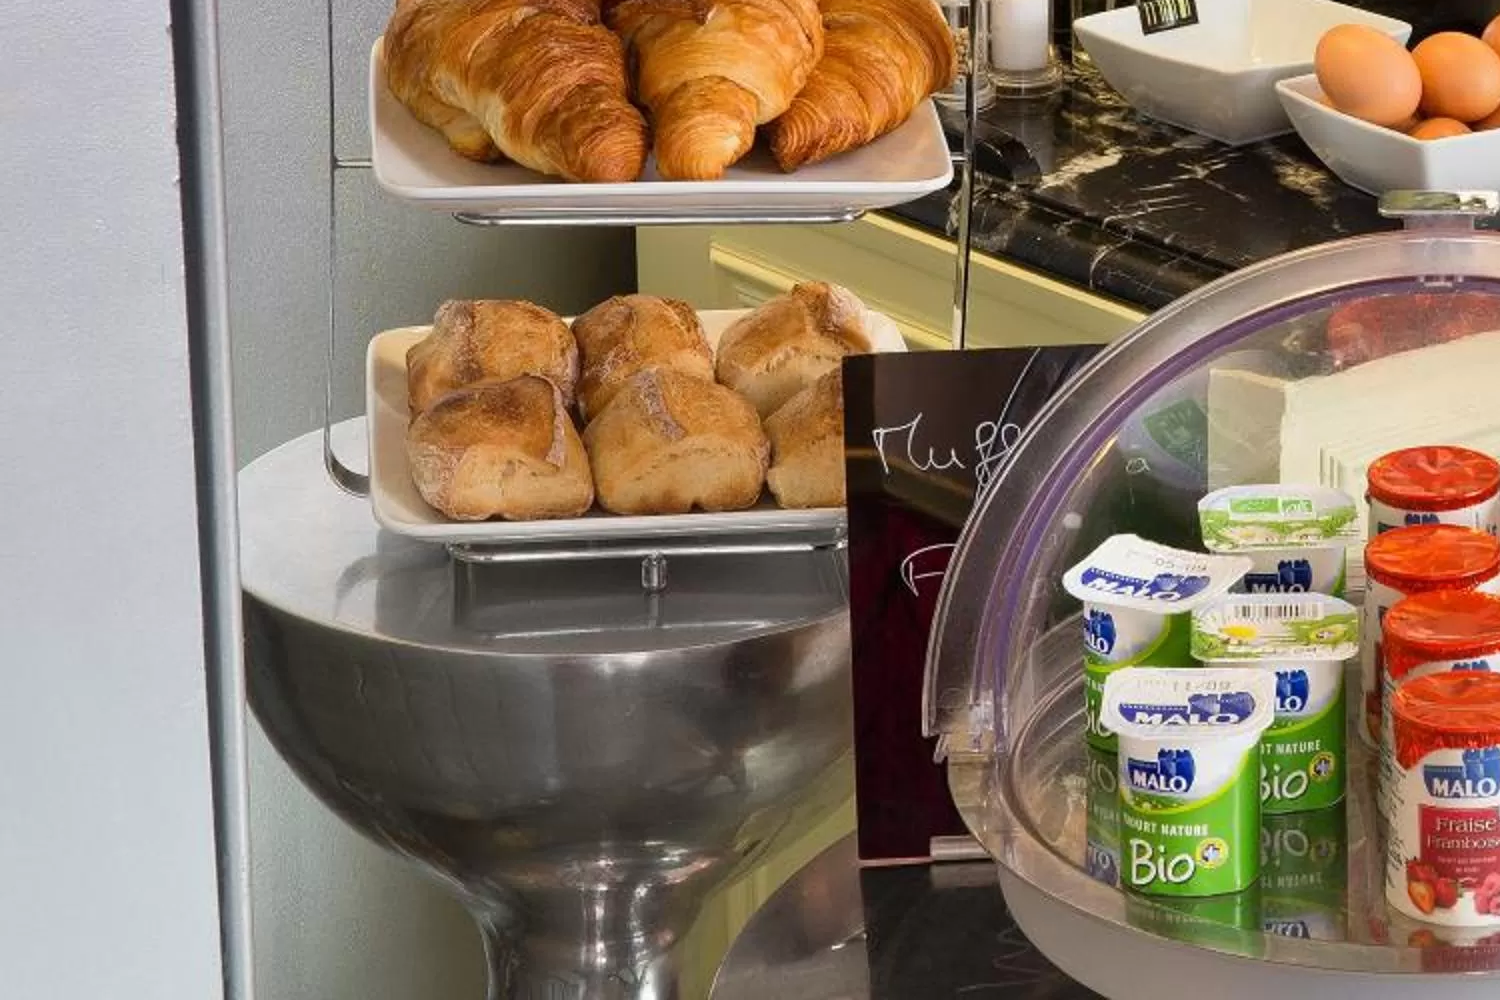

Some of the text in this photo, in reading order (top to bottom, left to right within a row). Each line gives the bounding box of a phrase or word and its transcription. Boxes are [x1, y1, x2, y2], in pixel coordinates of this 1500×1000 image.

[1275, 695, 1303, 713] LO
[1134, 711, 1240, 727] MALO
[1133, 769, 1187, 794] MALO
[1432, 776, 1497, 798] MALO
[1161, 823, 1209, 837] NATURE
[1435, 816, 1497, 833] Fraise
[1129, 837, 1196, 886] Bio
